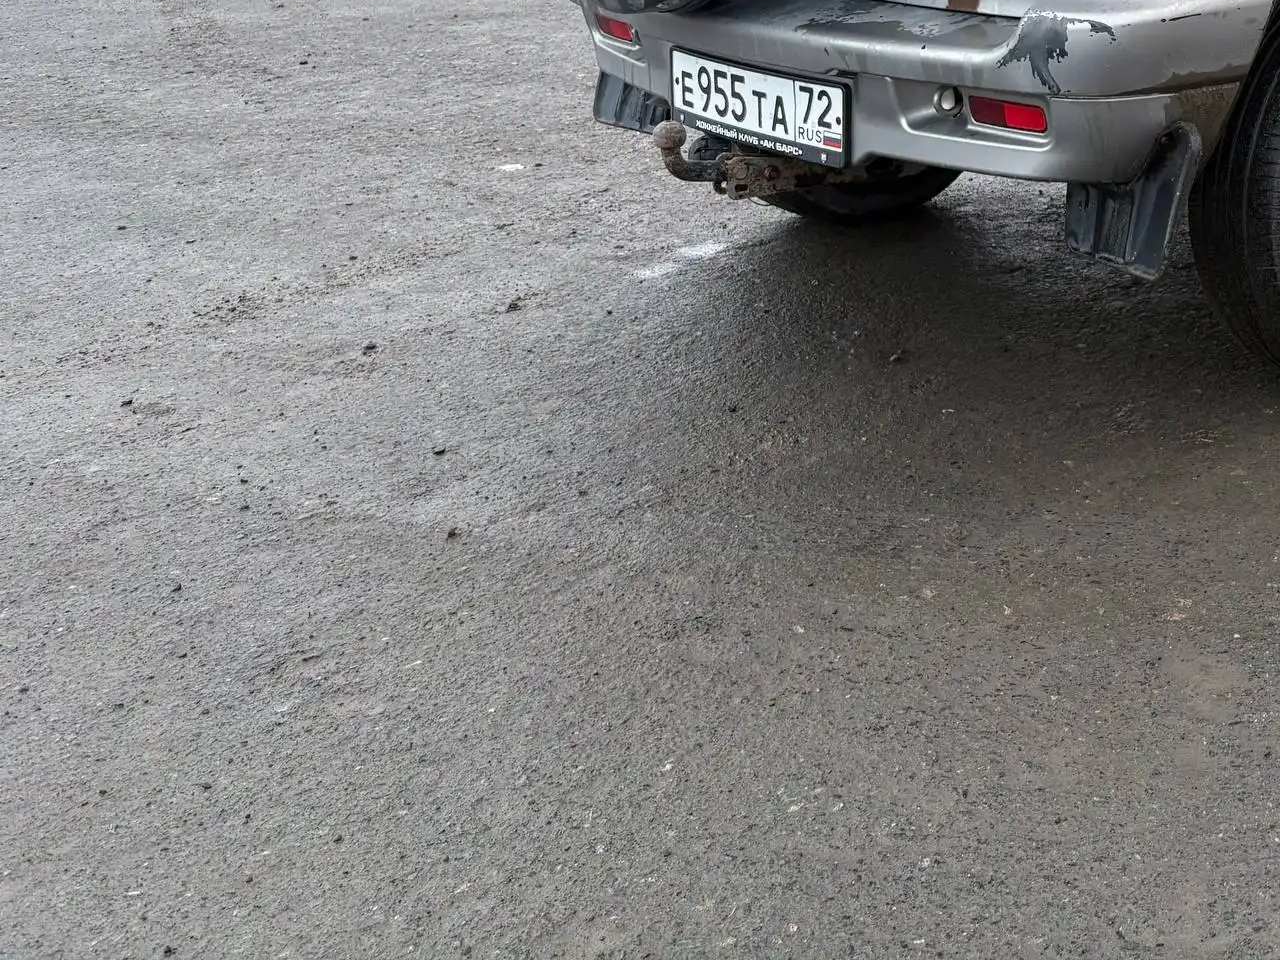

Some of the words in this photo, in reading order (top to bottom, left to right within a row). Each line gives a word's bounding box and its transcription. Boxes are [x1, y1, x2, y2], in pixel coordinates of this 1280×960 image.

[798, 85, 833, 130] 72
[695, 119, 738, 140] ХОККЕЙНЫЙ
[738, 131, 759, 145] КЛУБ
[798, 126, 823, 144] RUS
